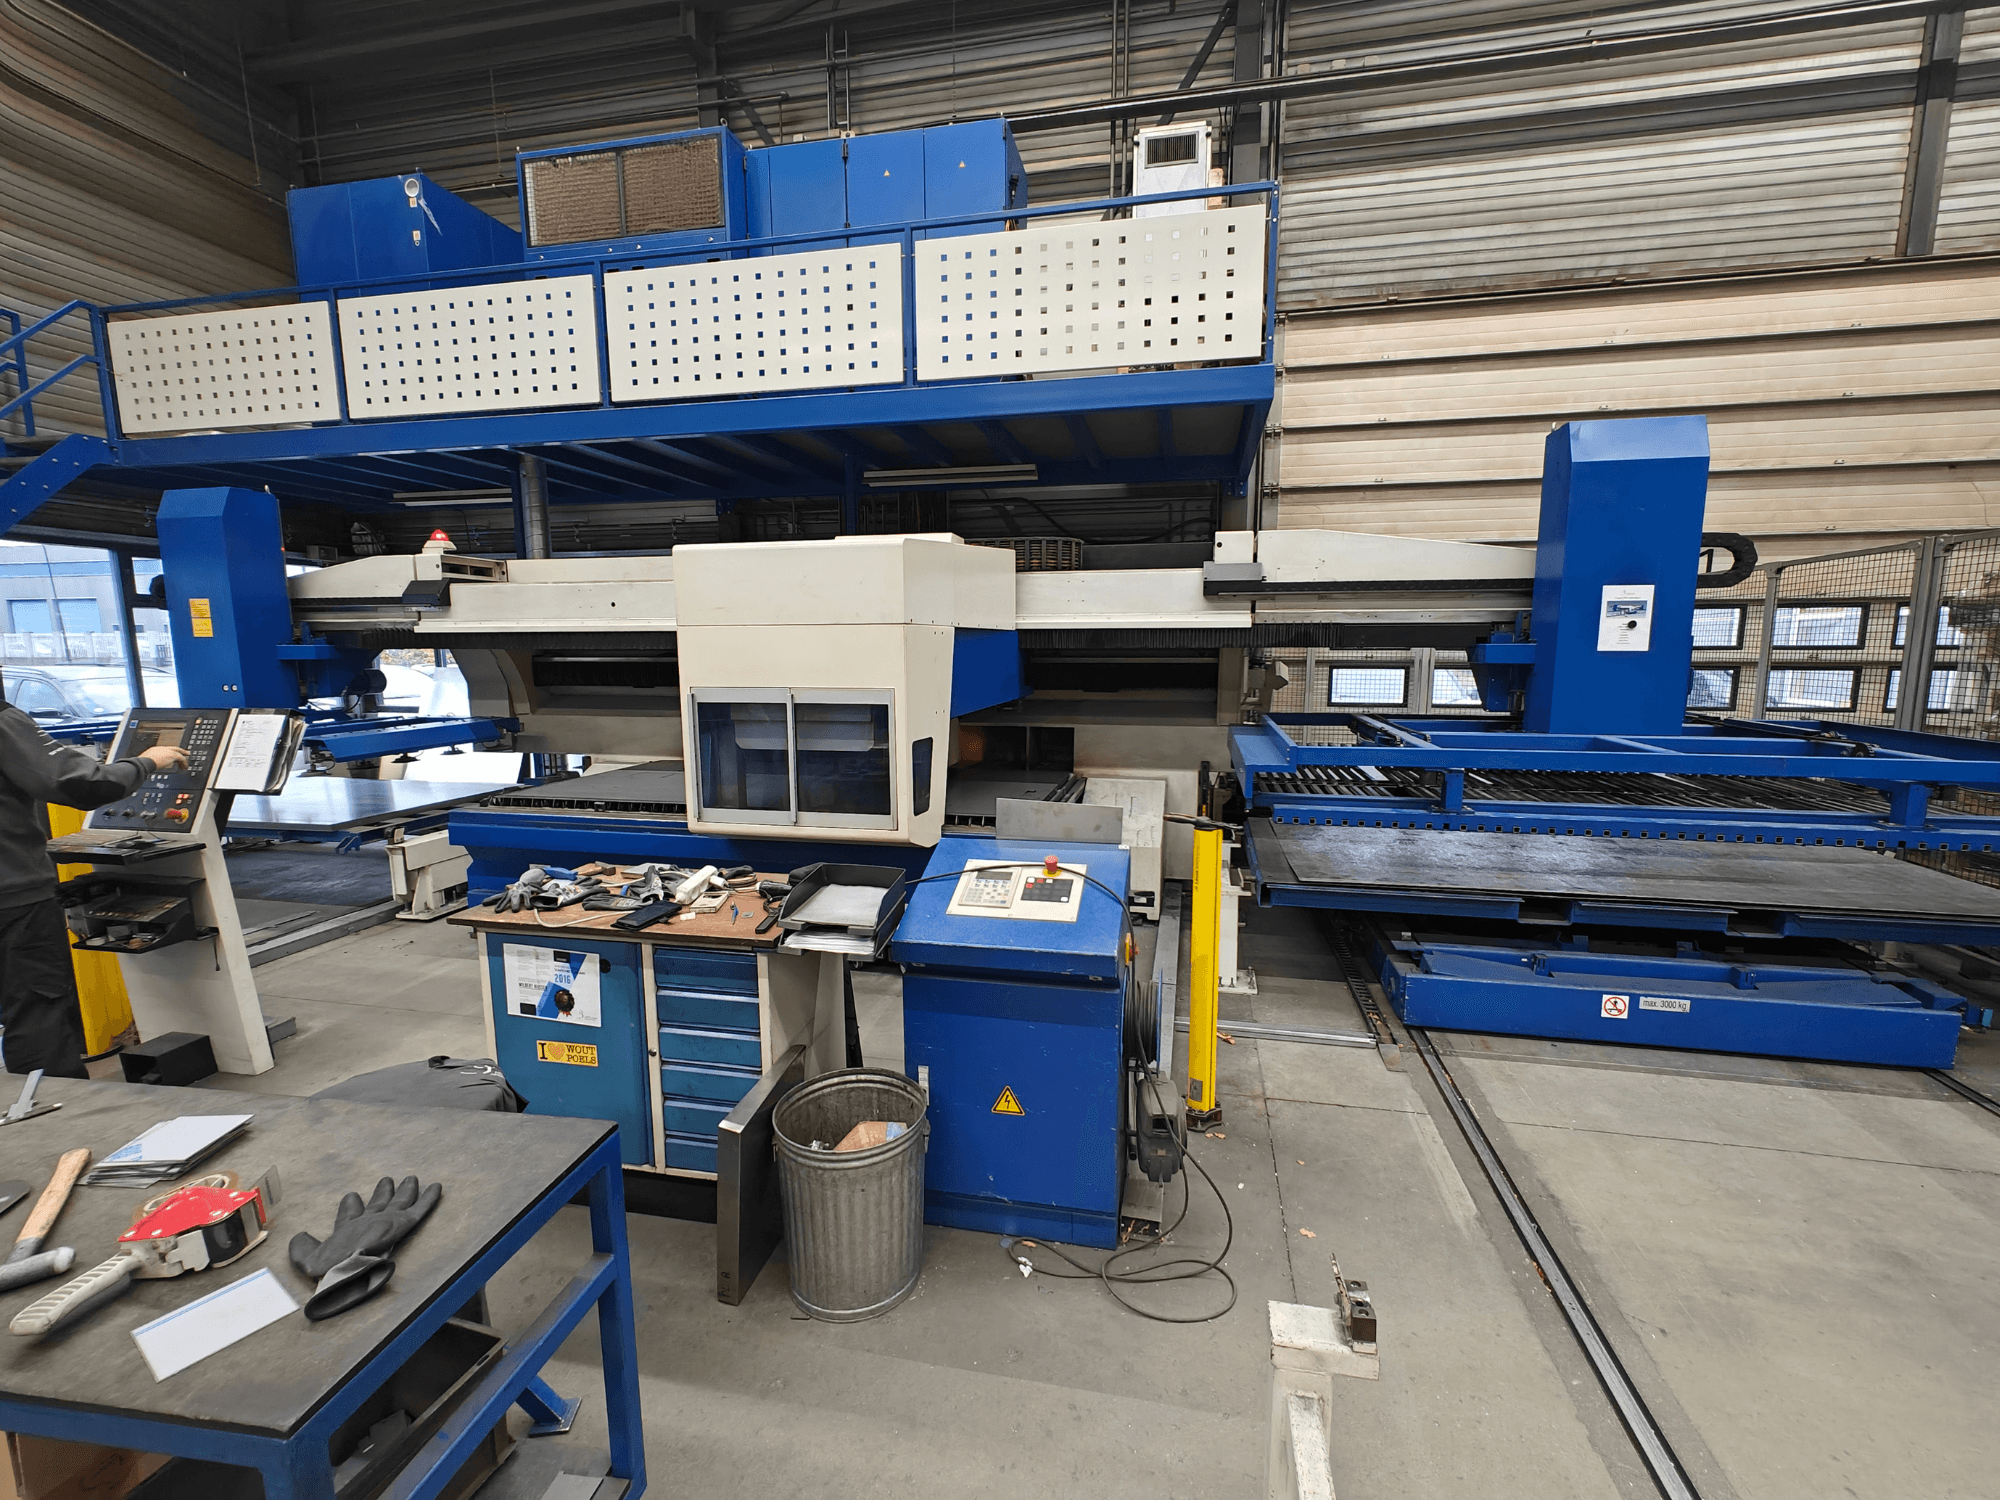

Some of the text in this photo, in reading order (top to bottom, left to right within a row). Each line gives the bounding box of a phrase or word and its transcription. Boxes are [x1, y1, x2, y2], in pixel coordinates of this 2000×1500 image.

[554, 973, 571, 985] 2016
[1642, 1000, 1687, 1012] max. 3000 kg
[538, 1042, 596, 1060] I WOUT
[566, 1054, 597, 1065] POELS
